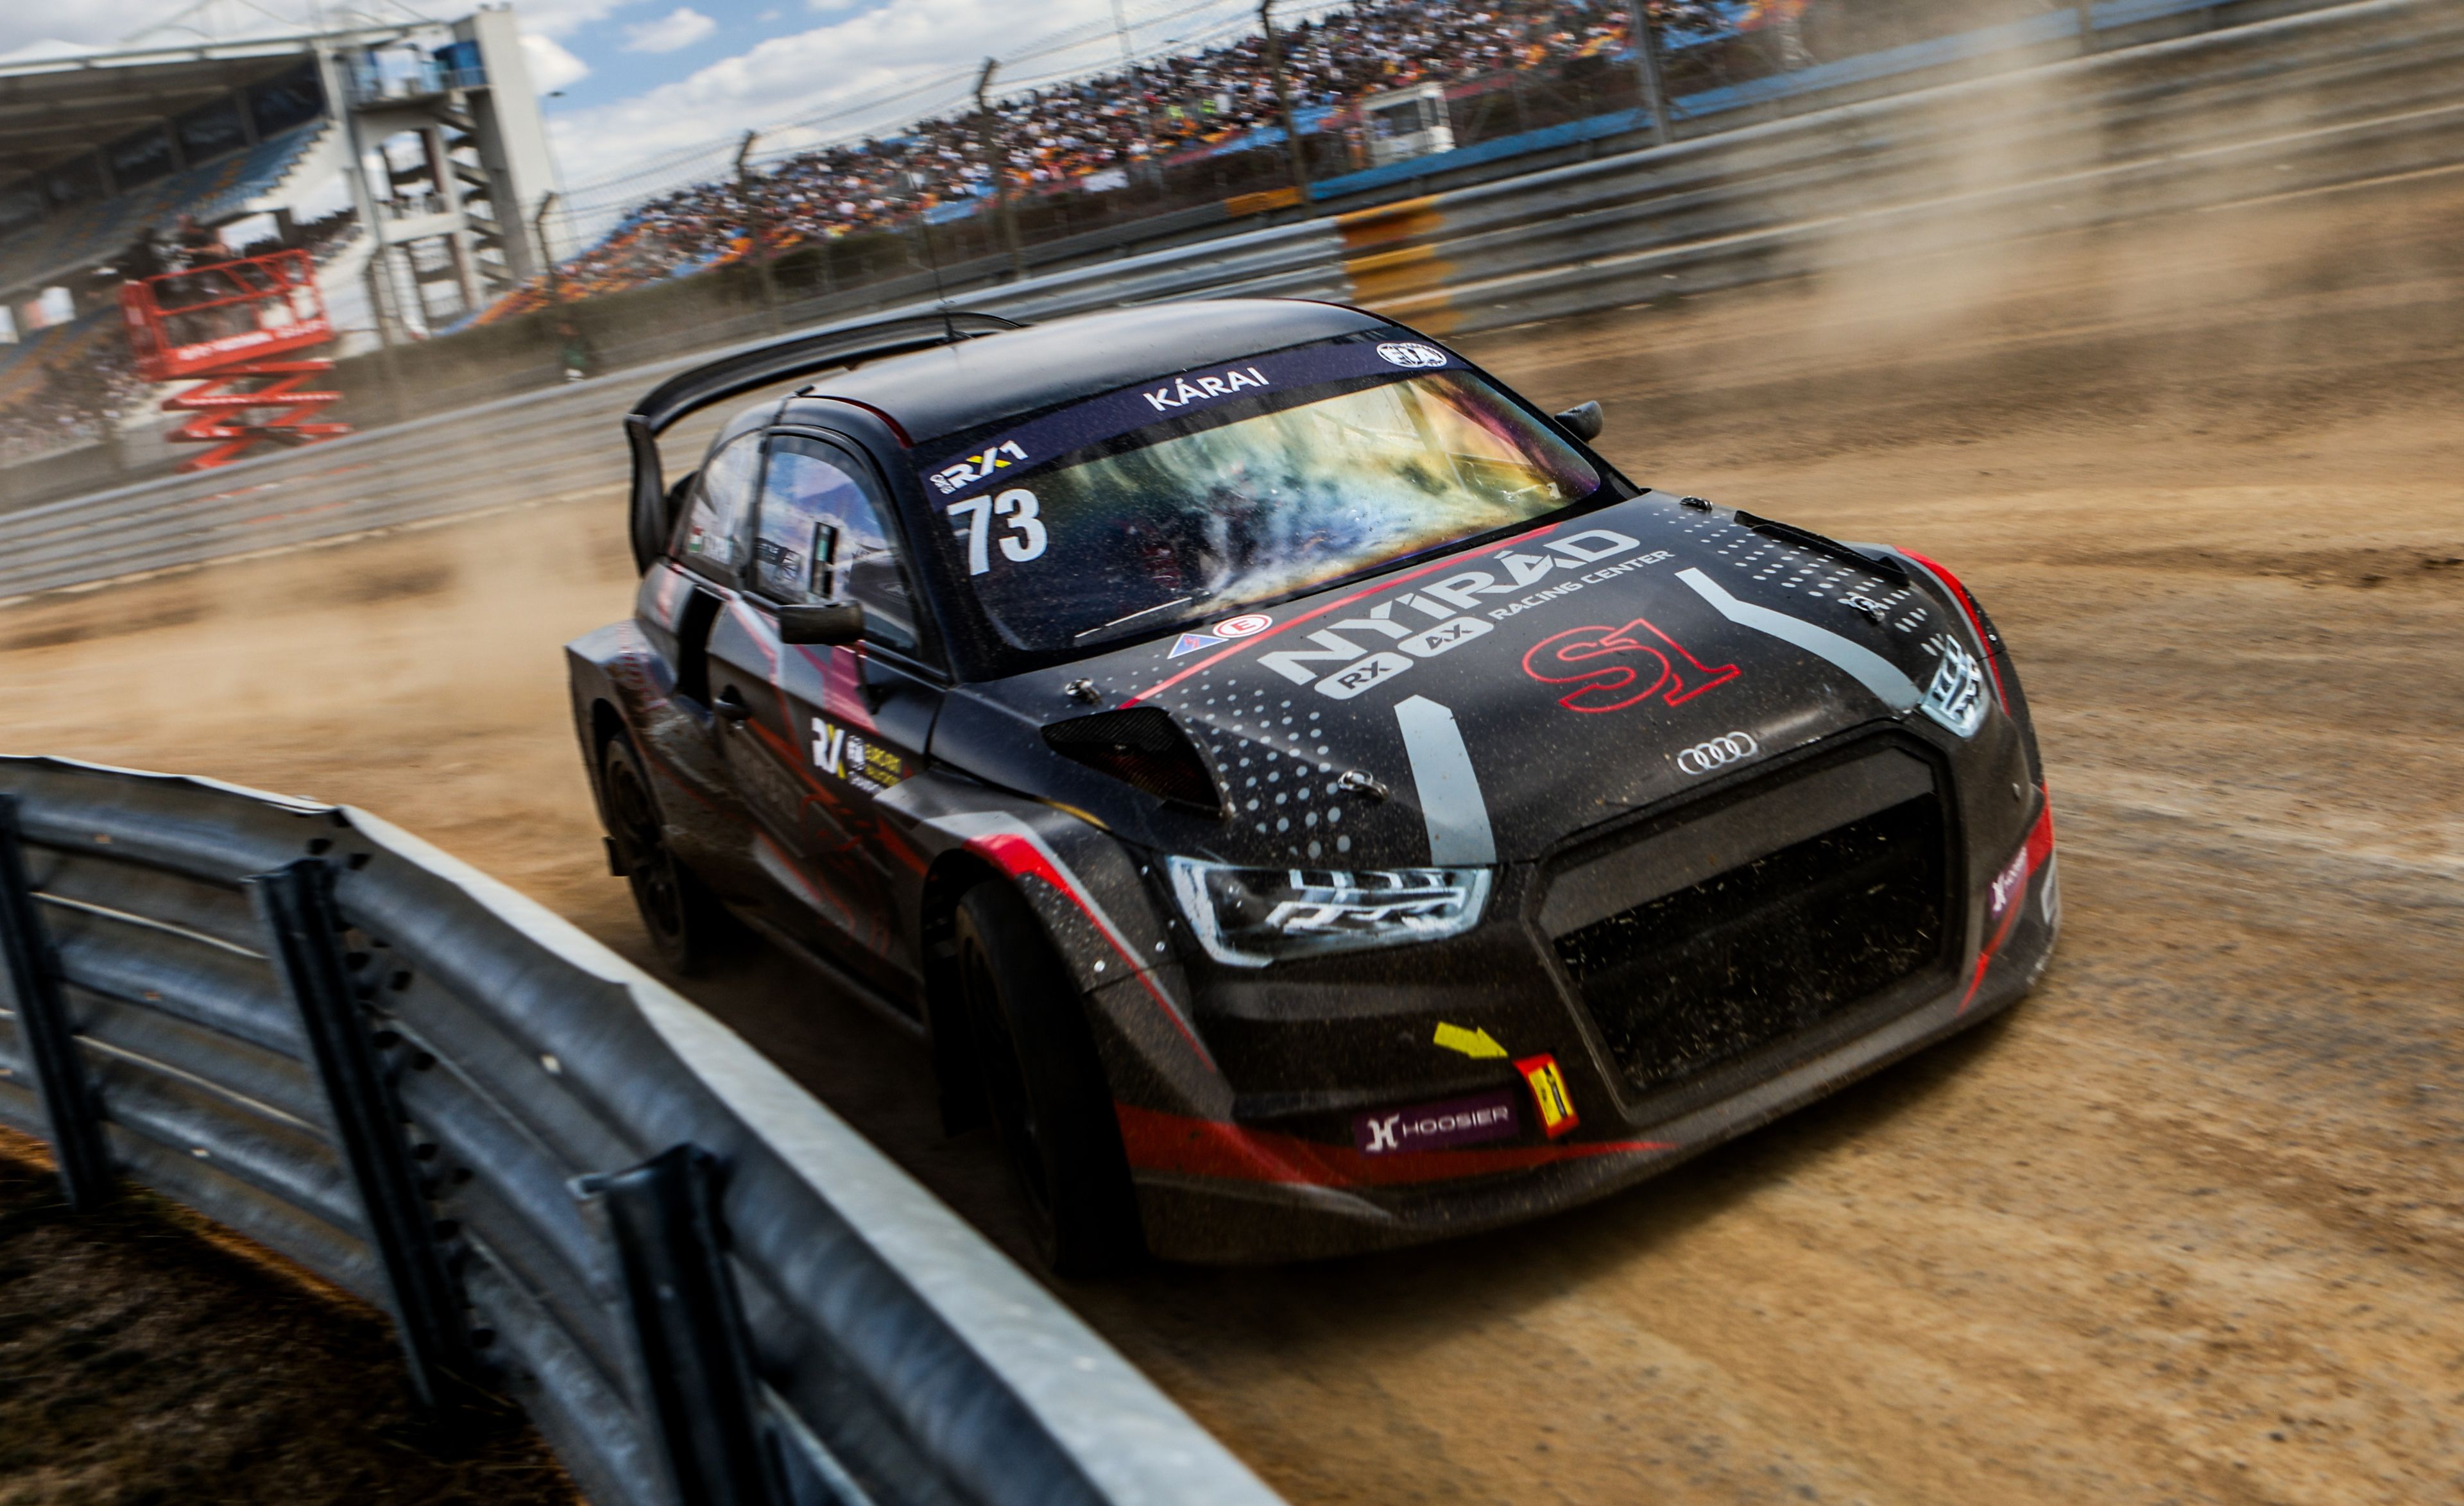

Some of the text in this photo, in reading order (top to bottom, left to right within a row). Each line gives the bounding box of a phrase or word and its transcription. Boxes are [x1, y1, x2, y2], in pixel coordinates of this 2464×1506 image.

[1380, 345, 1442, 364] FIA
[1143, 366, 1270, 412] KÁRAI
[940, 440, 1029, 489] RX1
[946, 488, 1048, 576] 73
[1580, 550, 1676, 585] CENTER
[1337, 622, 1475, 690] RX AX
[1521, 617, 1743, 714] S1
[1402, 1105, 1509, 1138] HOOSIER
